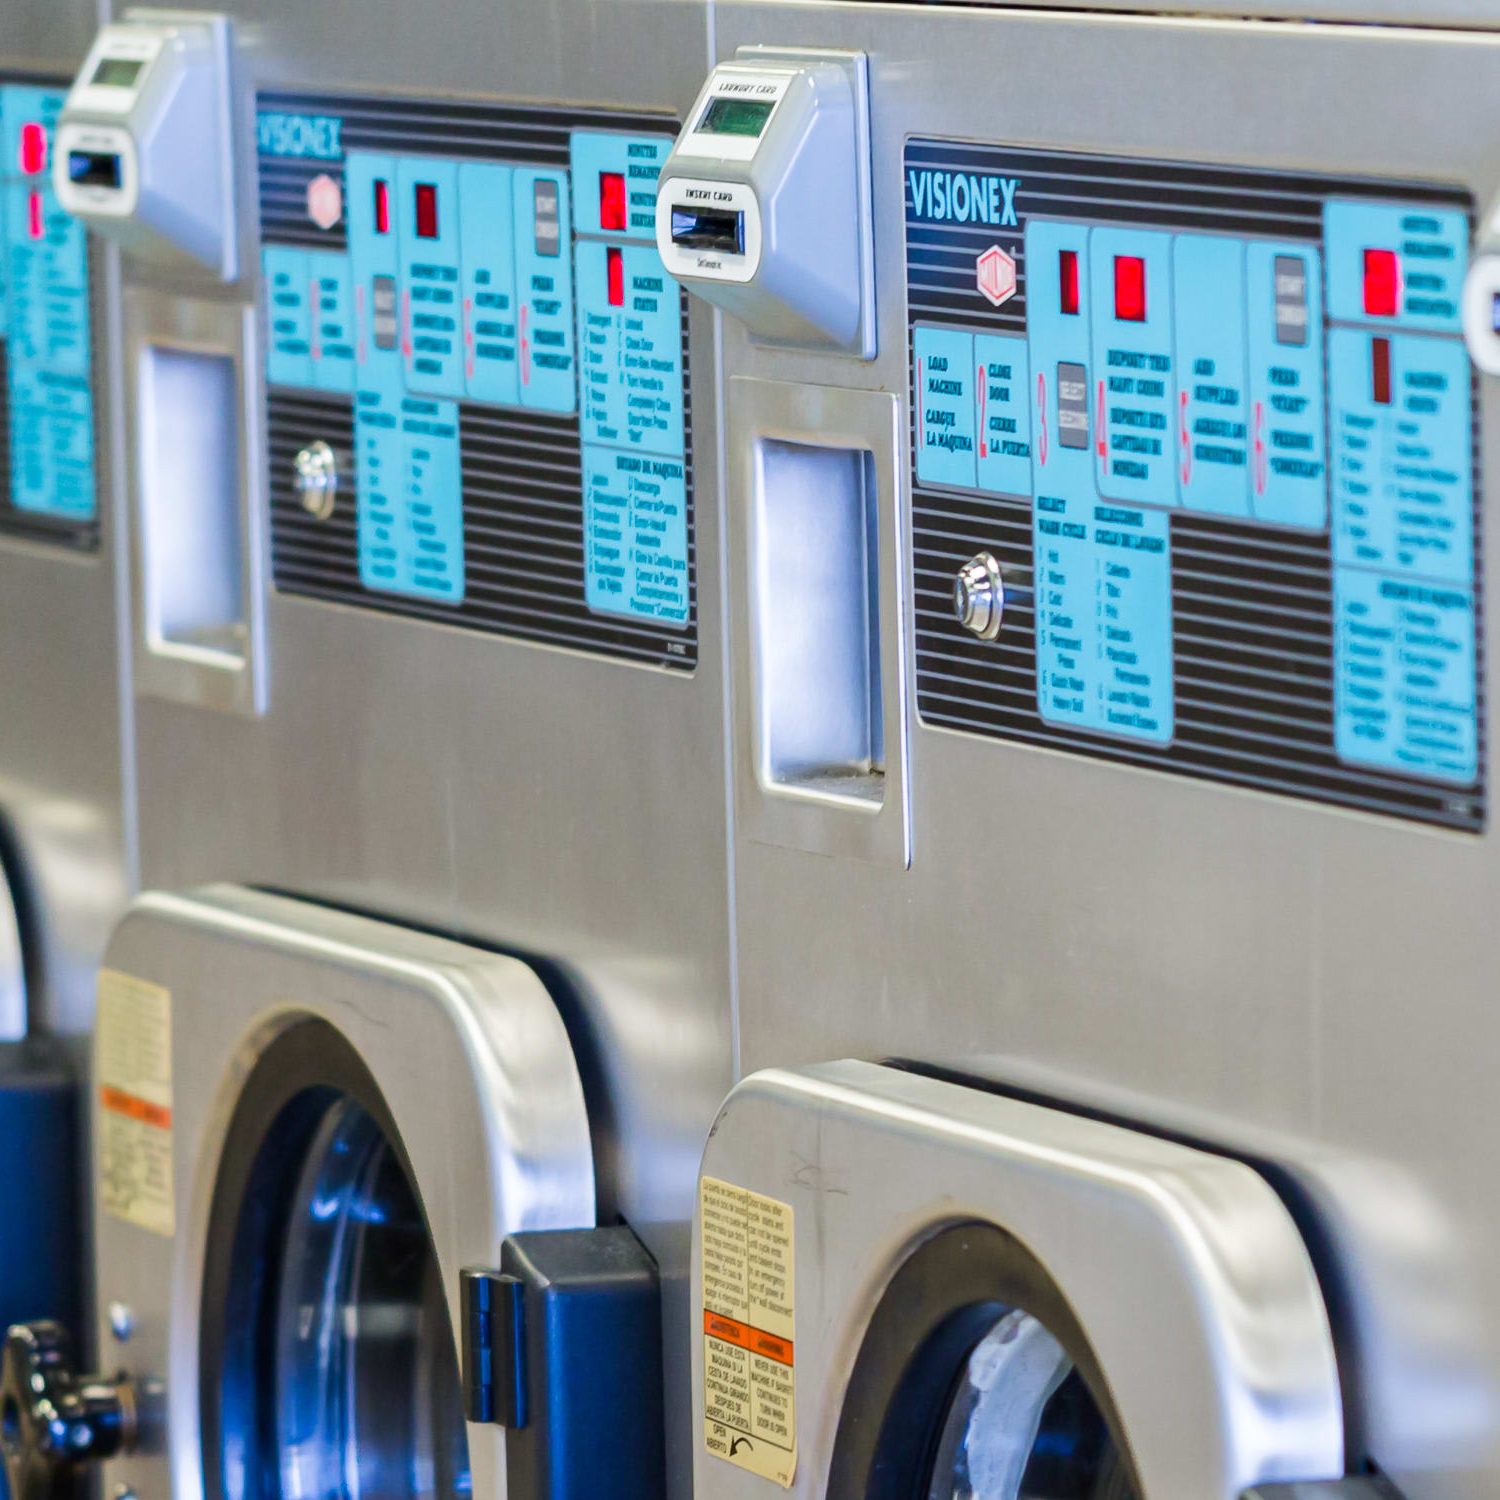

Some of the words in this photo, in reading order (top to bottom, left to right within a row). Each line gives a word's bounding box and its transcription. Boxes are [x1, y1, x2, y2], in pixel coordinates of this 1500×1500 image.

[718, 82, 755, 94] LAUNDRY
[756, 85, 777, 95] CARD
[686, 189, 711, 200] INSERT
[713, 191, 733, 202] CARD
[909, 170, 1018, 226] VISIONEX
[927, 356, 948, 372] LOAD
[988, 364, 1012, 380] CLOSE
[928, 379, 963, 396] MACHINE
[989, 386, 1010, 402] DOOR
[926, 432, 937, 447] LA
[990, 439, 1000, 454] LA
[713, 1424, 727, 1438] OPEN
